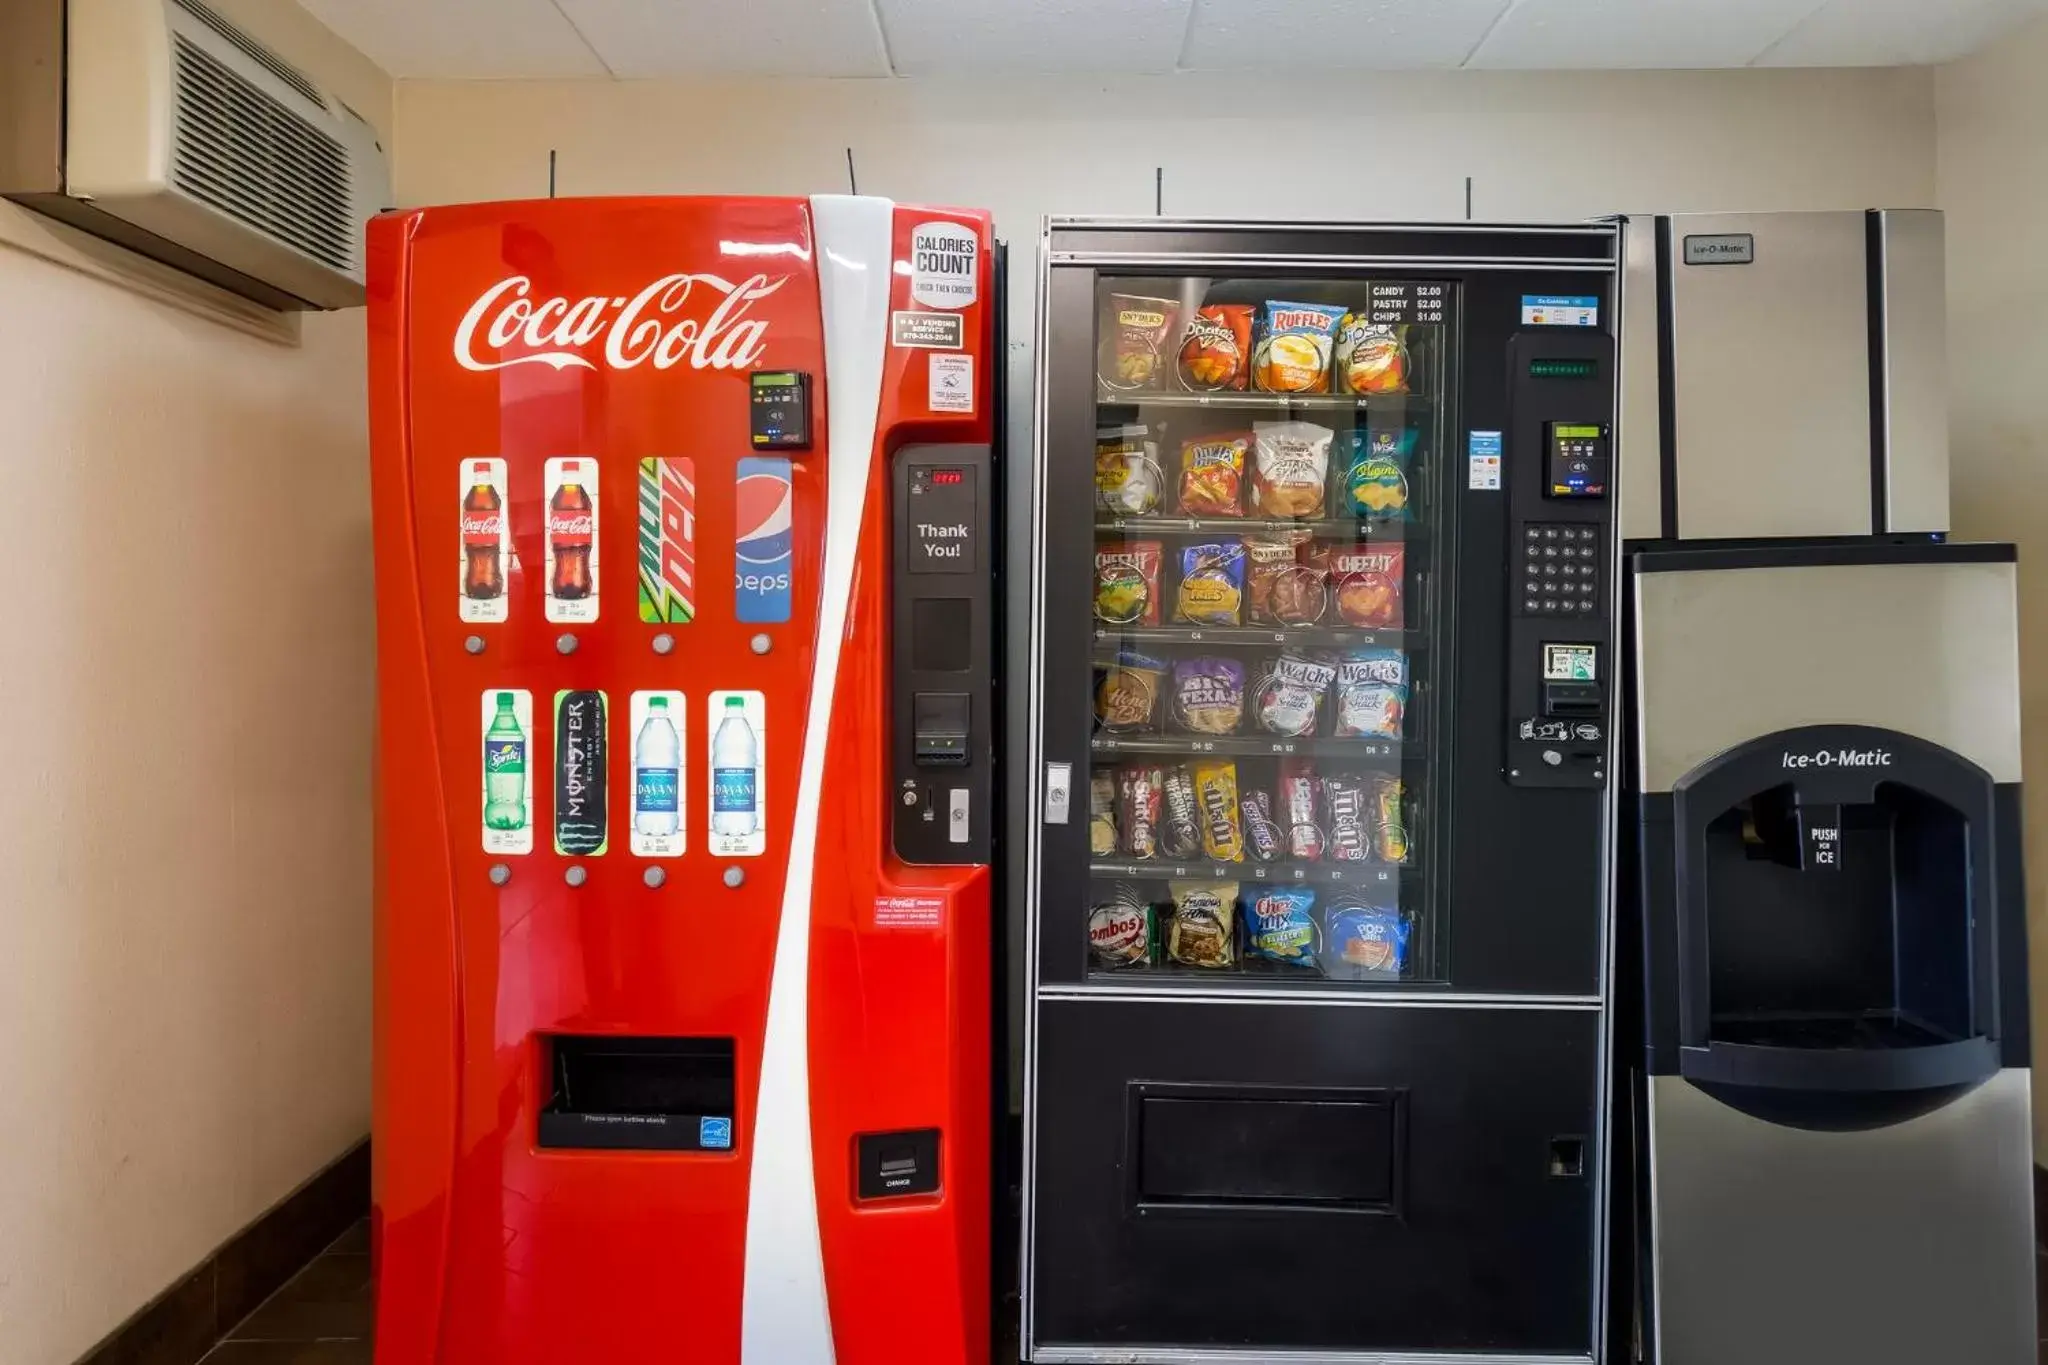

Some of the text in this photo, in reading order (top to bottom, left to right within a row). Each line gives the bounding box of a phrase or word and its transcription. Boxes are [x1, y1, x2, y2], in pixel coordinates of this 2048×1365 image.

[916, 236, 974, 253] CALORIES
[1693, 245, 1744, 254] Ice-O-Matic
[916, 252, 974, 275] COUNT
[1372, 287, 1442, 297] CANDY $2.00
[1372, 300, 1442, 309] PASTRY $2.00
[453, 273, 789, 371] Coca-Cola
[1273, 311, 1332, 331] RUFFLES
[1372, 312, 1442, 322] CHIPS $1.00
[1186, 322, 1235, 341] Doritos
[462, 515, 502, 534] Coca-Cola
[550, 515, 592, 534] Coca-Cola
[917, 524, 968, 538] Thank
[925, 544, 961, 557] You!
[1337, 556, 1392, 573] CHEEZ-IT
[1279, 661, 1332, 685] Welch's
[1342, 664, 1399, 681] Welch's
[492, 749, 520, 770] Sprite
[568, 700, 585, 817] MONSTER
[1782, 748, 1892, 768] Ice-O-Matic
[637, 784, 677, 796] DASANI
[715, 784, 754, 796] DASANI
[1811, 828, 1838, 840] PUSH
[1816, 851, 1834, 864] ICE
[1256, 898, 1294, 918] Chex
